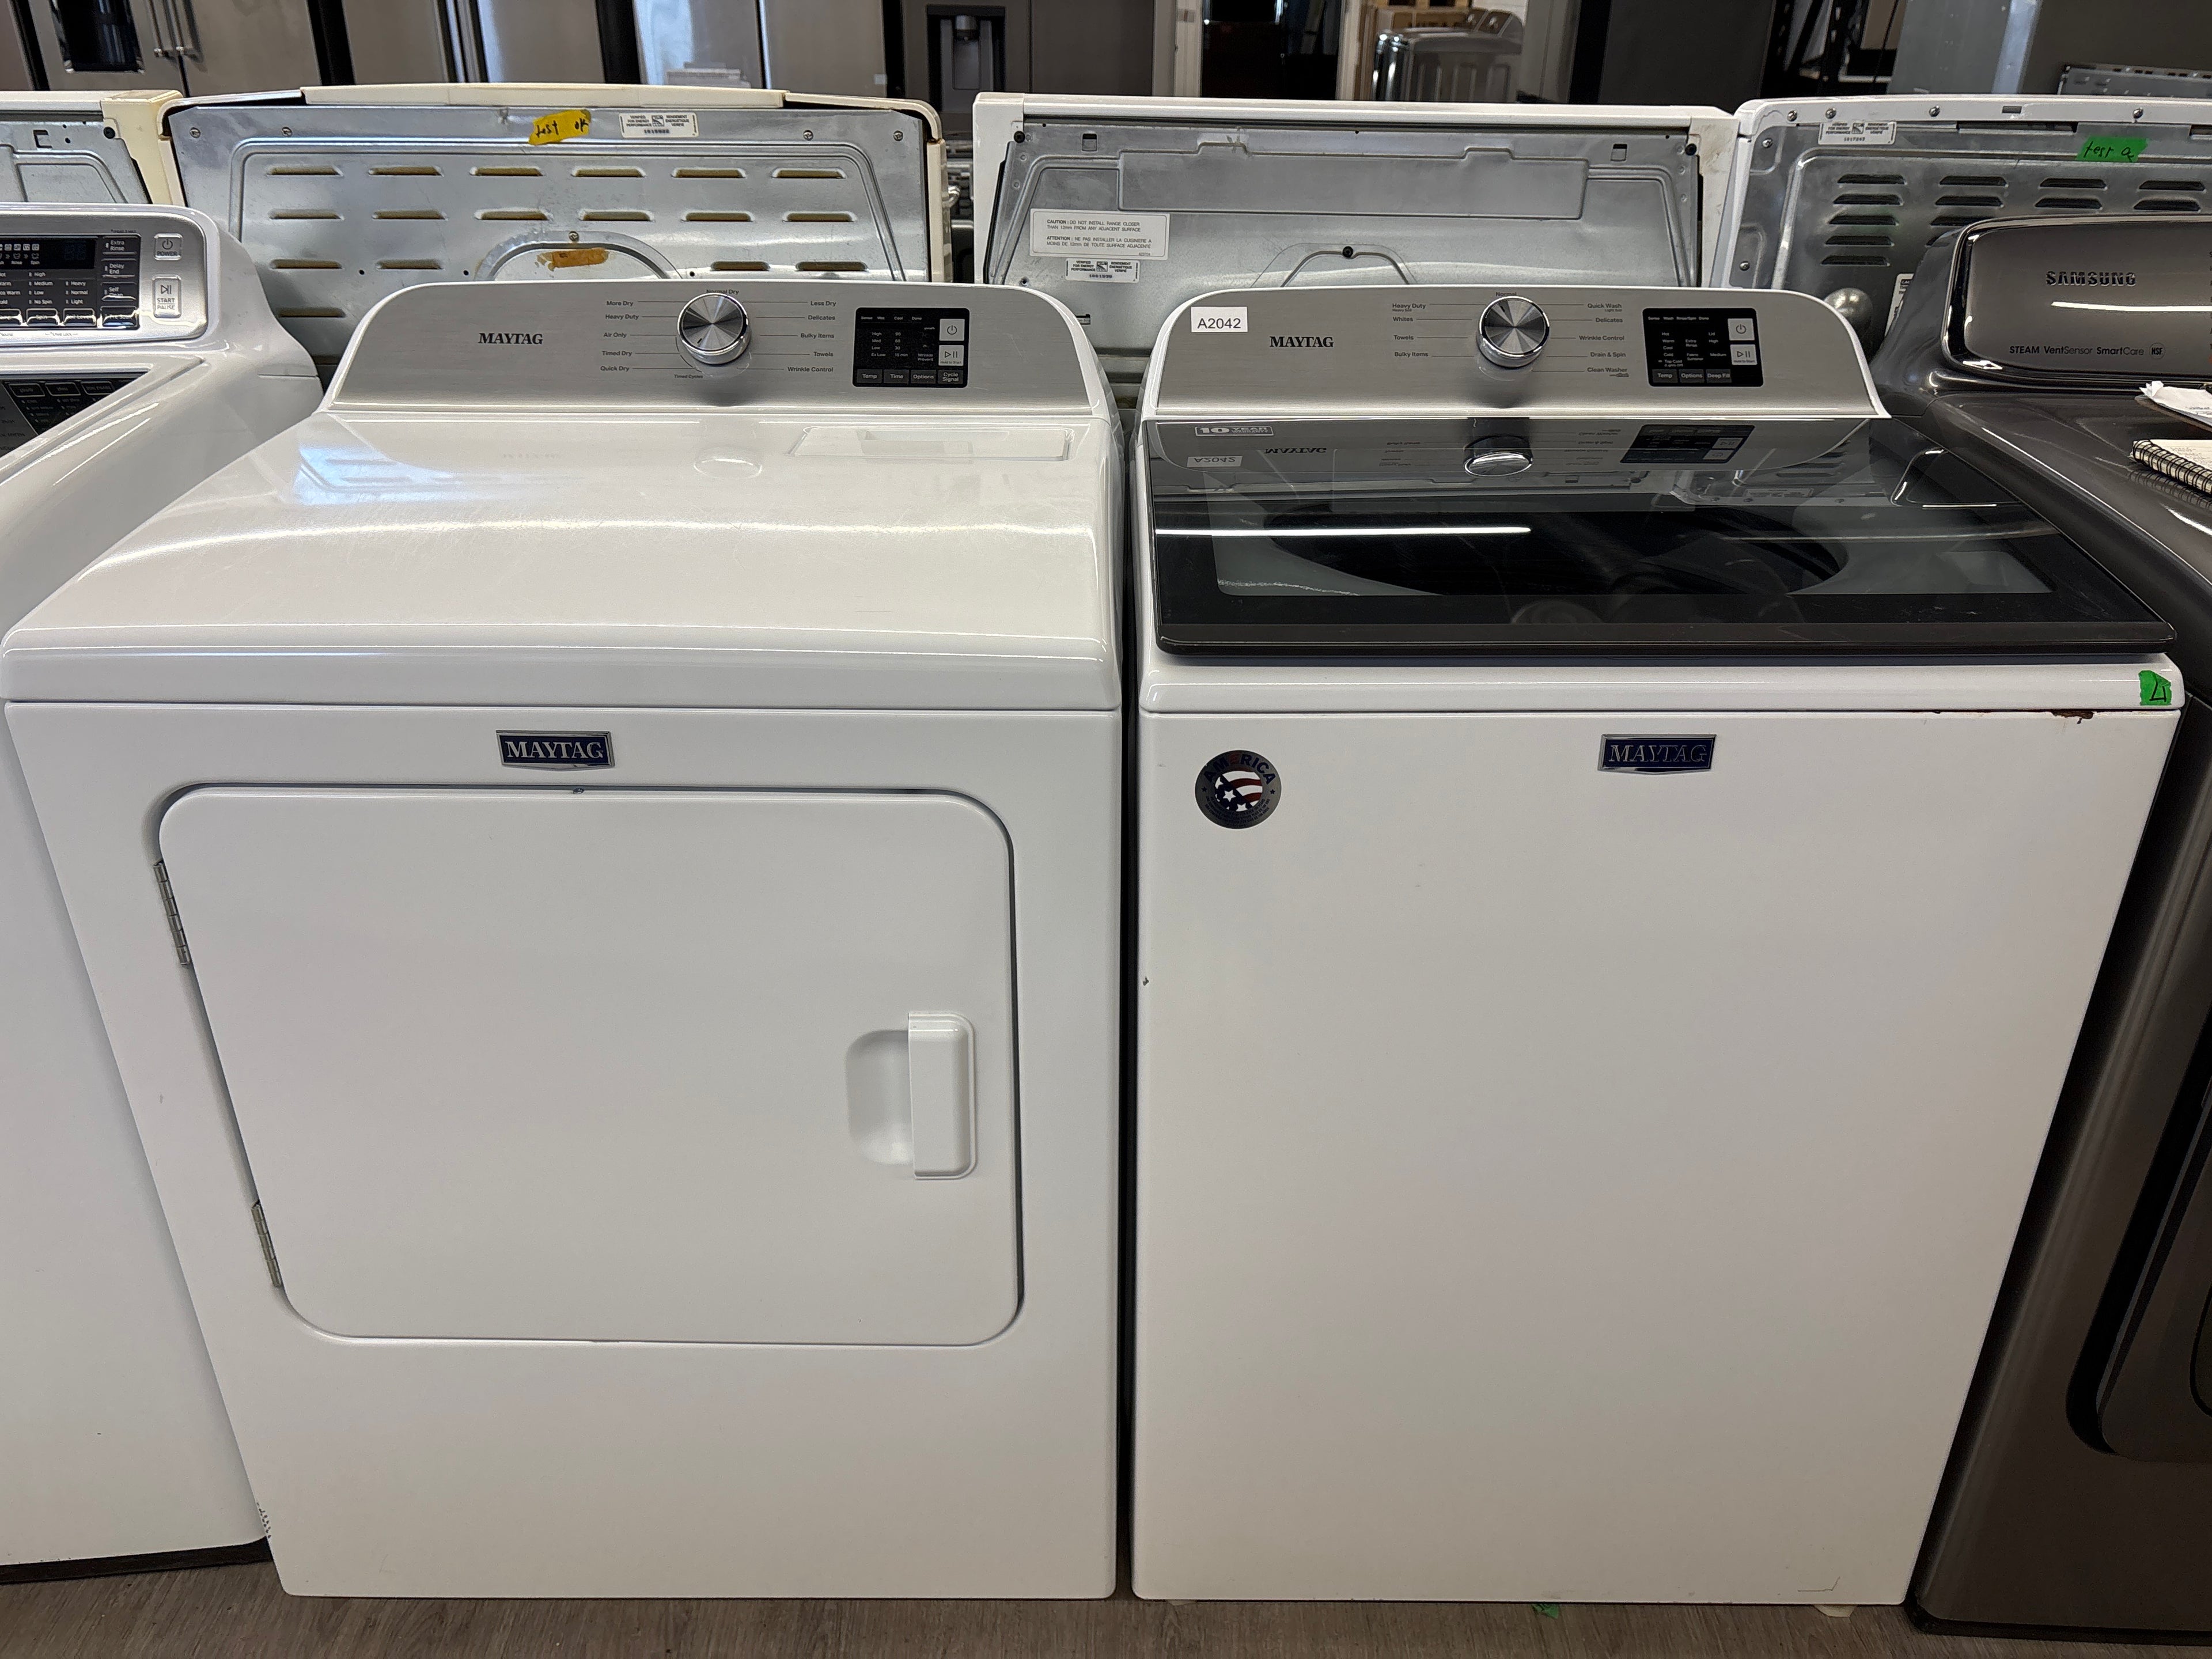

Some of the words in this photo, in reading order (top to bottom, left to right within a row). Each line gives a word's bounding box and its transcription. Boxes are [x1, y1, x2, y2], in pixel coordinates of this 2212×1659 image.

[2046, 271, 2137, 286] SAMSUNG
[1197, 318, 1241, 329] A2042
[478, 333, 543, 344] MAYTAG
[1269, 336, 1334, 348] MAYTAG
[2009, 346, 2040, 354] STEAM
[2044, 346, 2092, 355] VentSensor
[2096, 346, 2144, 355] SmartCare
[505, 741, 604, 759] MAYTAG
[1608, 745, 1707, 762] MAYTAG
[1203, 753, 1276, 785] AMERICA
